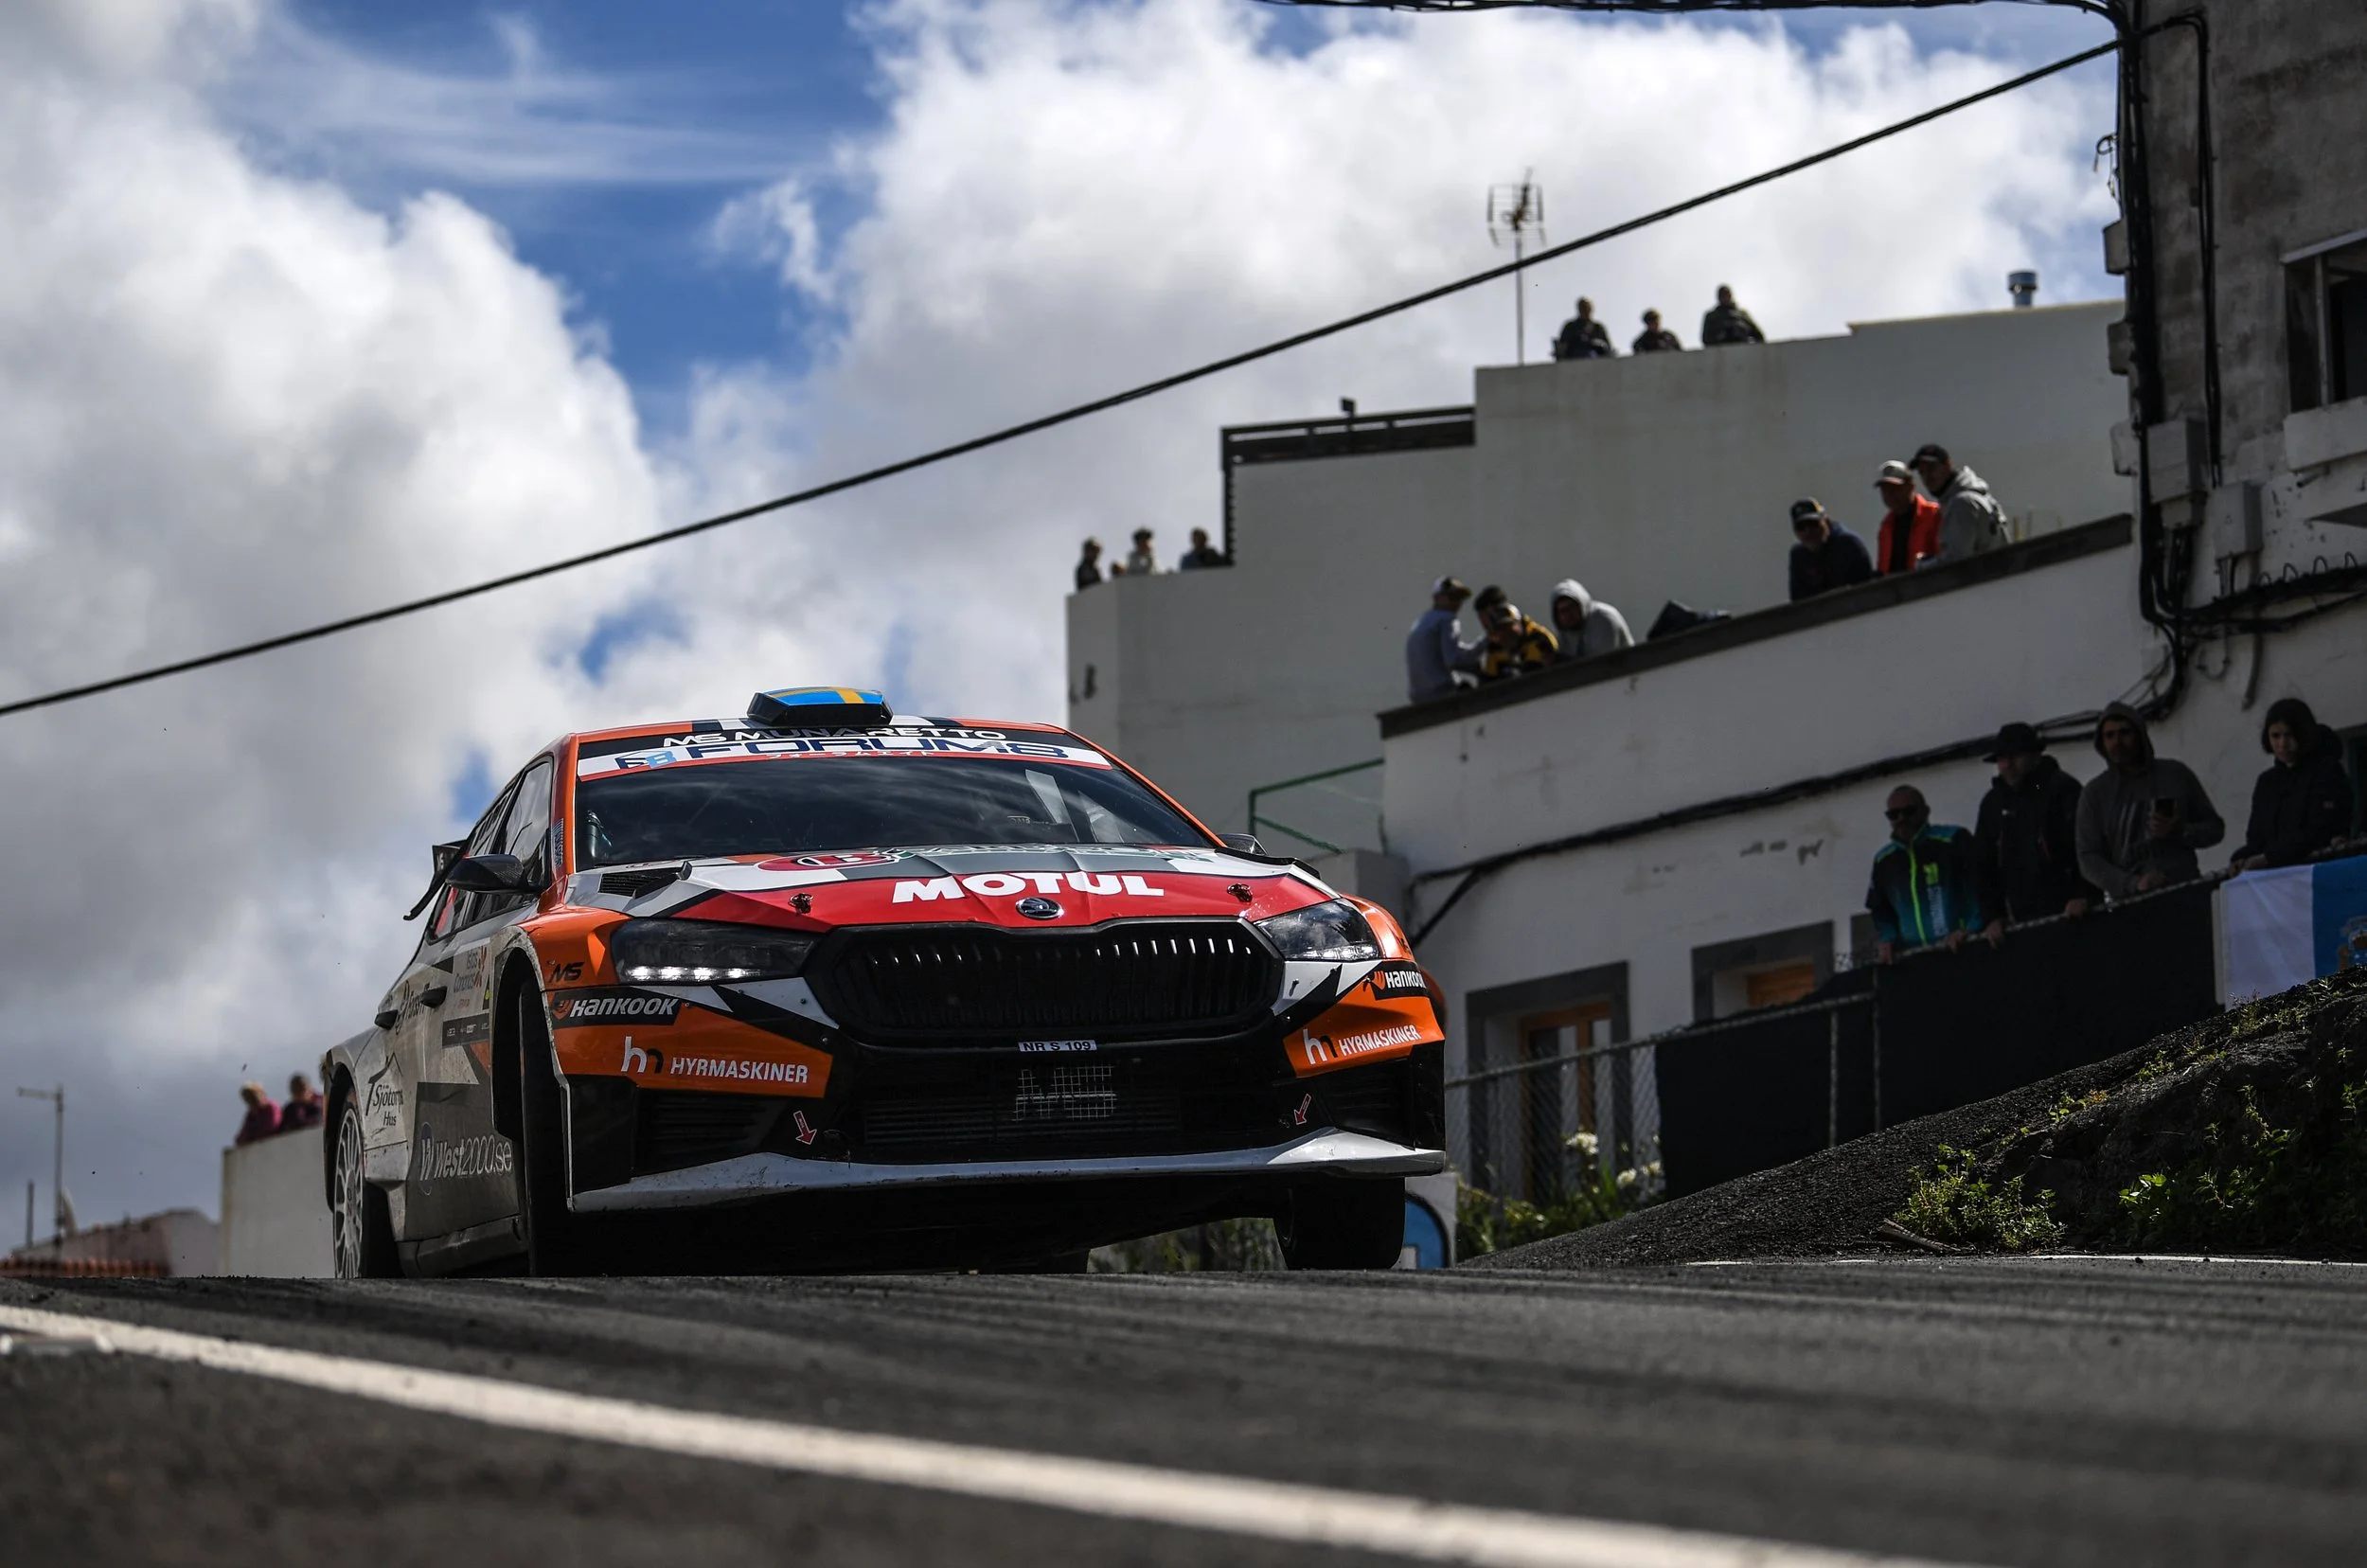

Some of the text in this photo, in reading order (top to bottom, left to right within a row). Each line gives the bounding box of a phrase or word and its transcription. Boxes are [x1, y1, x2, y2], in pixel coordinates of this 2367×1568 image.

[664, 727, 1006, 747] MS MUNARETTO
[685, 738, 1070, 759] FORUM8
[892, 870, 1165, 903] MOTUL
[548, 961, 584, 983] MS
[1050, 1042, 1061, 1051] S
[1065, 1041, 1092, 1050] 109
[1338, 1025, 1422, 1057] HYRMASKINER
[669, 1057, 809, 1083] HYRMASKINER
[383, 1111, 397, 1126] Hus
[434, 1133, 512, 1179] West2000.se
